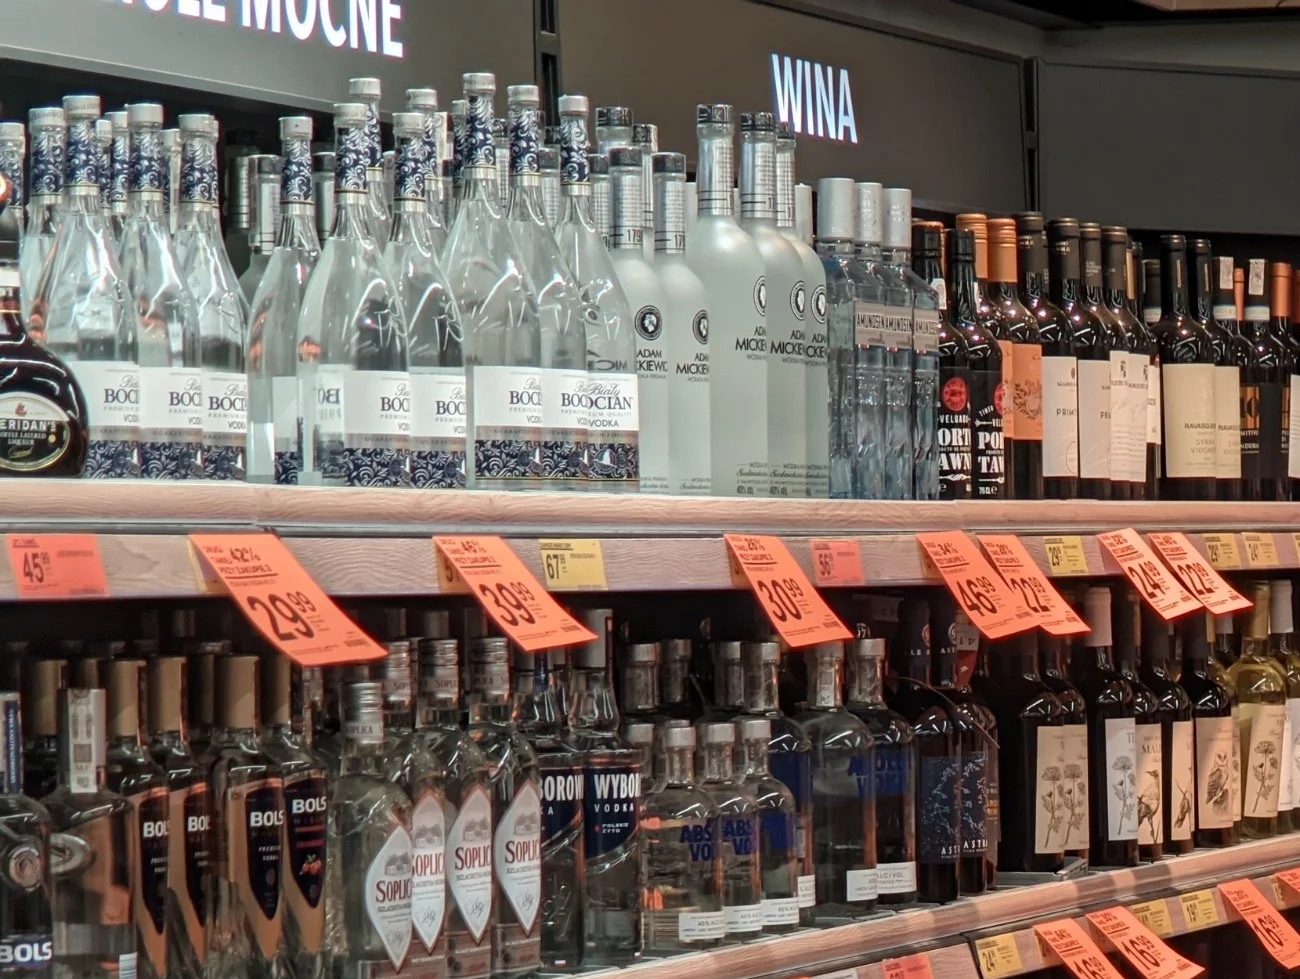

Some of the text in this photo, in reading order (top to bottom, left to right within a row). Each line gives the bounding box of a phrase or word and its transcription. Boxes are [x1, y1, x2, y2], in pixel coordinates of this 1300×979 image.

[771, 53, 858, 144] WINA
[857, 313, 884, 328] AMUNDSEN
[589, 419, 619, 427] VODKA
[292, 796, 326, 814] BOLS
[594, 804, 634, 814] VODKA
[188, 816, 209, 832] BOL
[251, 810, 284, 827] BOLS
[143, 821, 169, 838] BOL
[455, 847, 492, 871] SOPLIC
[505, 840, 541, 864] SOPLIC
[412, 850, 445, 875] SOPLIC
[376, 880, 412, 903] SOPLIC
[0, 942, 52, 962] BOLS
